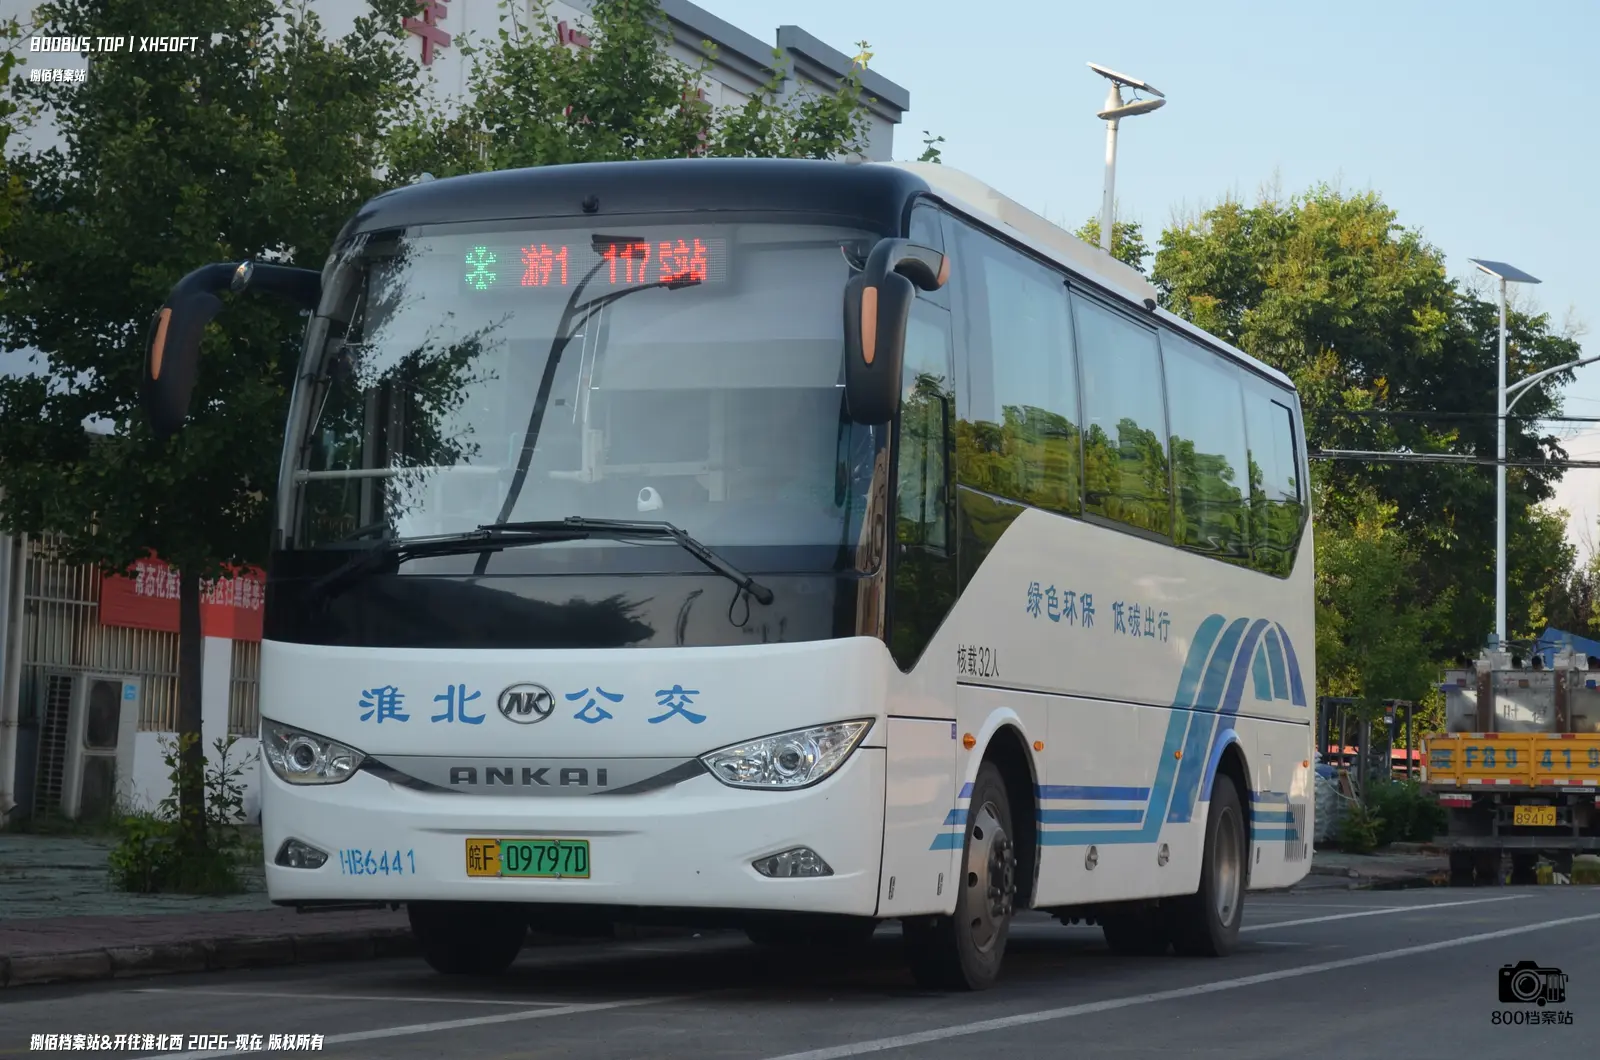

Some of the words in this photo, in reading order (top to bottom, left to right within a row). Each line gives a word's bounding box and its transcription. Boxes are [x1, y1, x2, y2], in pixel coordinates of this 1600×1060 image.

[521, 244, 568, 286] 游1
[1026, 581, 1096, 629] 绿色环保
[1112, 600, 1171, 643] 低碳出行
[956, 644, 1000, 678] 核载32人
[359, 683, 487, 725] 淮北
[565, 684, 707, 725] 公交
[450, 766, 608, 787] ANKAI
[1515, 813, 1554, 825] 89419
[339, 849, 416, 876] HB6441
[469, 845, 494, 871] 皖F
[506, 845, 587, 873] 09797D
